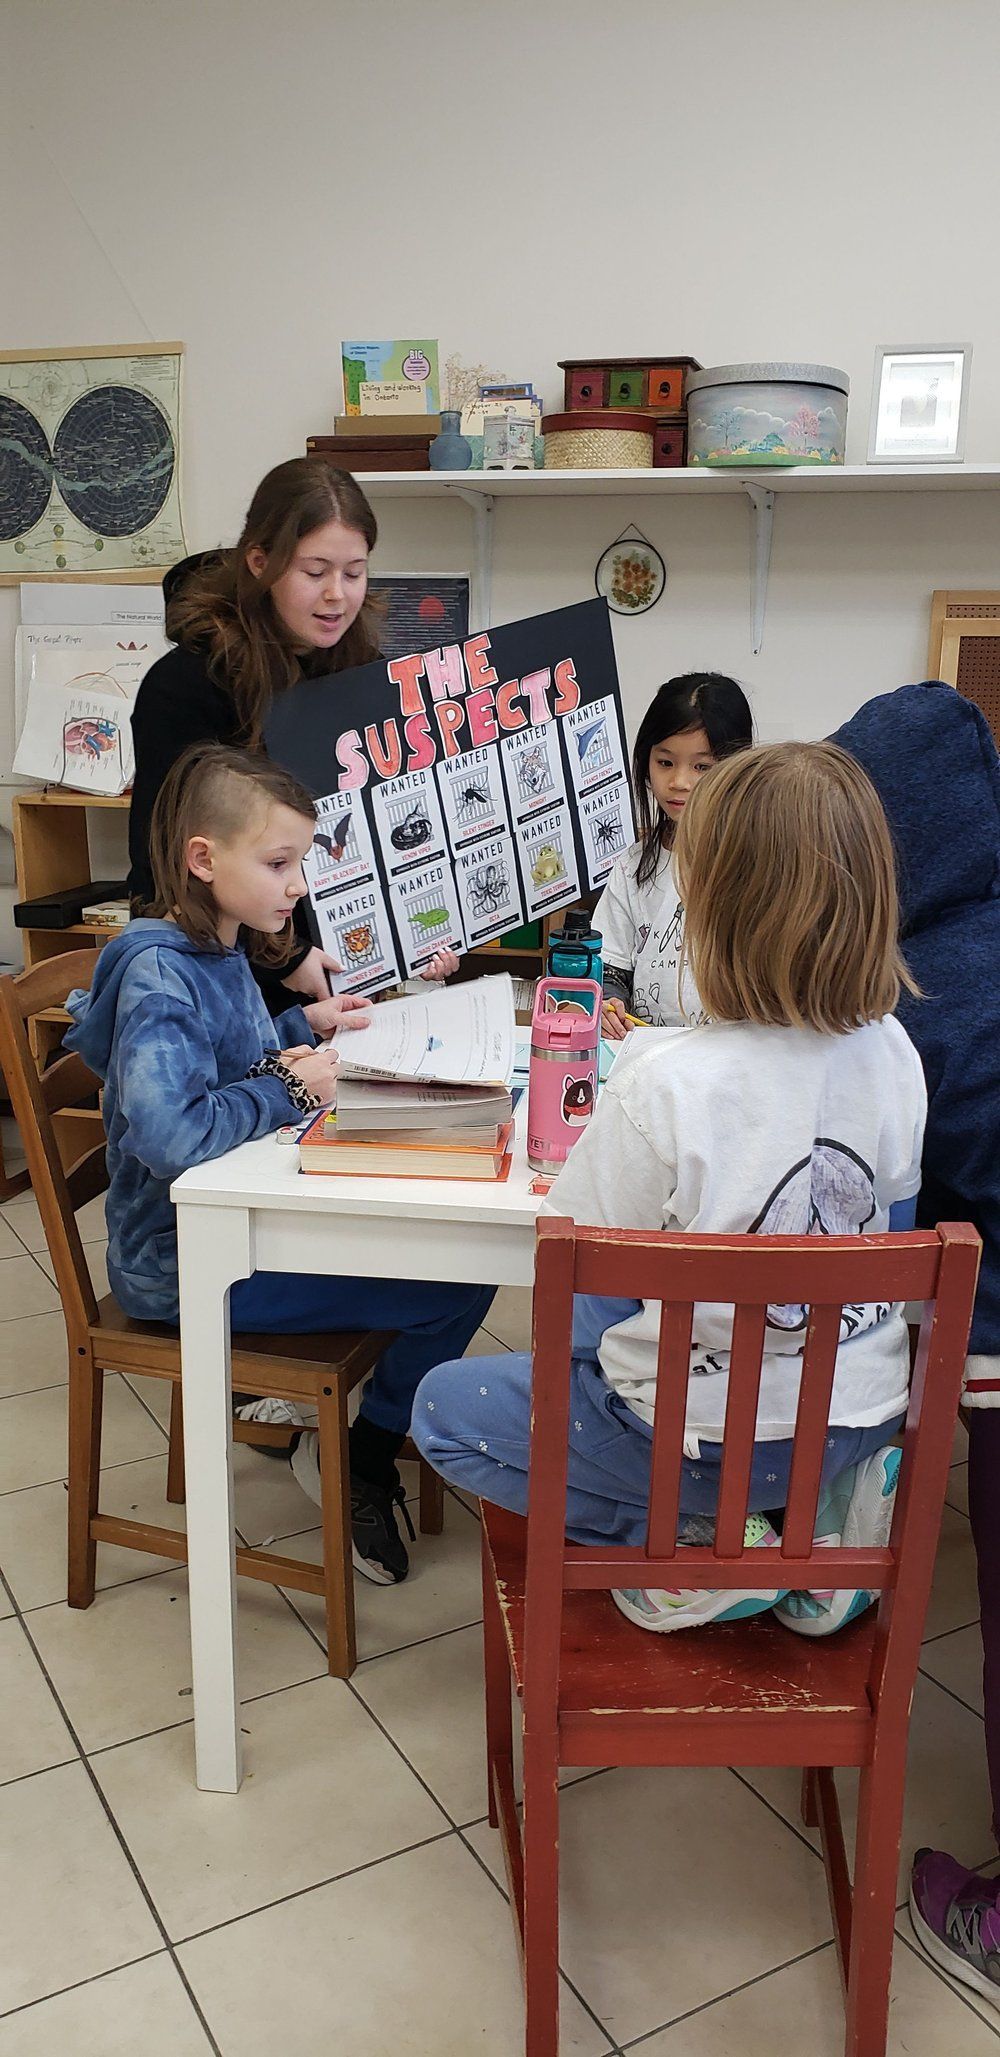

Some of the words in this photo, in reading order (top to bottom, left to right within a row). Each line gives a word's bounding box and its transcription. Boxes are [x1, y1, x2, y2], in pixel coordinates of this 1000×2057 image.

[409, 348, 424, 360] BIG
[361, 384, 380, 393] Living
[384, 383, 395, 391] and
[27, 635, 39, 644] The
[388, 633, 498, 716] THE
[335, 658, 580, 791] SUSPECTS
[568, 700, 606, 727] WANTED
[506, 724, 547, 751] WANTED
[444, 748, 488, 774] WANTED
[380, 772, 426, 798] WANTED
[583, 788, 620, 815] WANTED
[521, 815, 561, 842] WANTED
[418, 846, 432, 857] VIPER
[461, 842, 503, 869] WANTED
[398, 867, 443, 896] WANTED
[326, 893, 376, 922] WANTED
[416, 945, 432, 957] CHAOS
[529, 1139, 551, 1151] YETI
